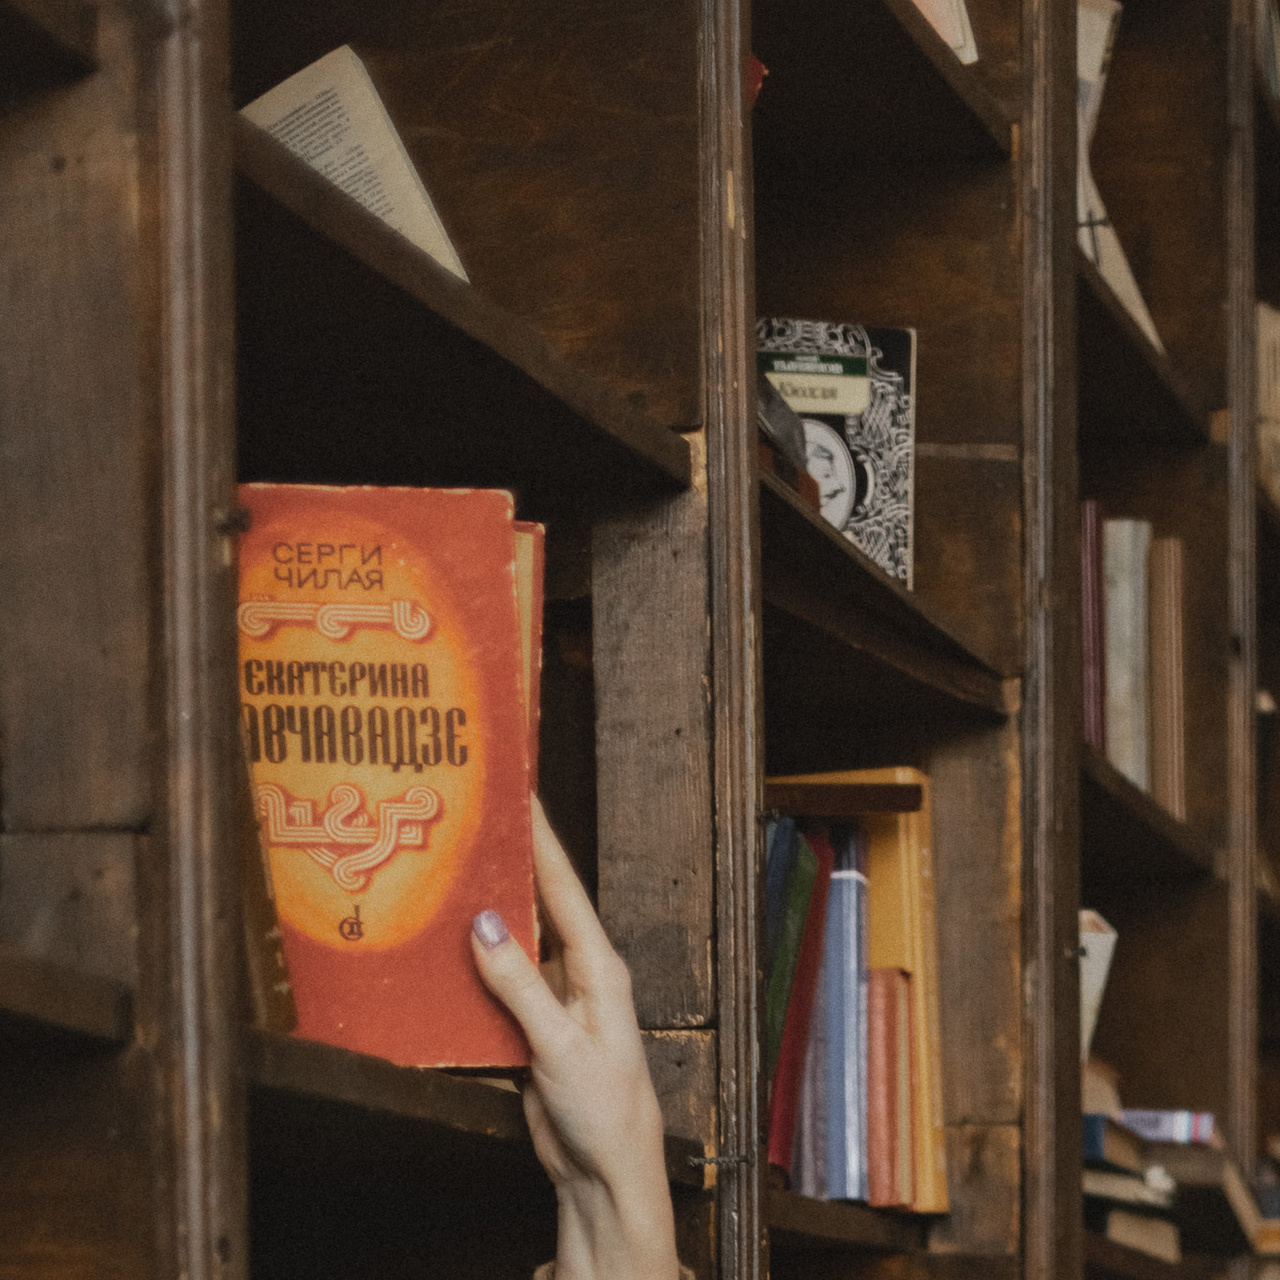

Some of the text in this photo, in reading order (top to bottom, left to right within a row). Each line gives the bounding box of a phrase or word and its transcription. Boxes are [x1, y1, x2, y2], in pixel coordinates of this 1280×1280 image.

[272, 541, 383, 567] СЕРГИ
[273, 568, 384, 591] ЧИЛАЯ
[244, 658, 430, 699] ЕКАТЕРИНА
